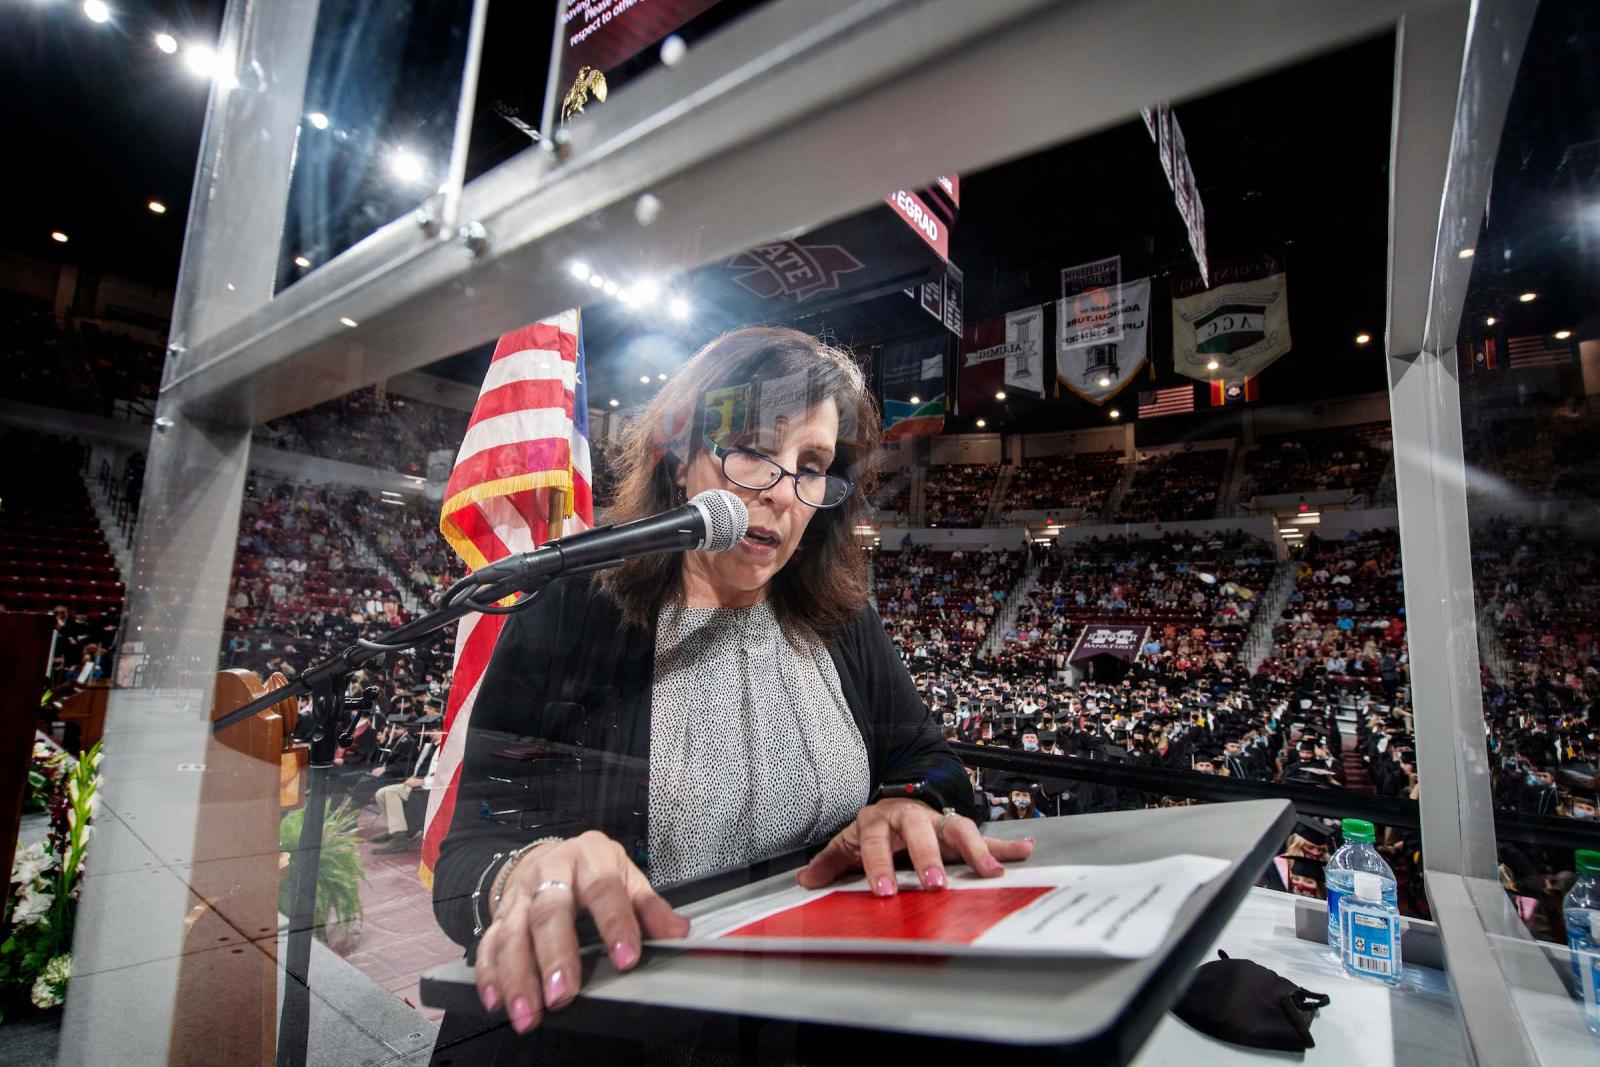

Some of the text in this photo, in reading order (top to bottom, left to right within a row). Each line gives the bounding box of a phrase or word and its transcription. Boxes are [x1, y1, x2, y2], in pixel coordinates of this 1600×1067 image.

[570, 17, 601, 46] respect
[602, 11, 612, 24] to
[756, 243, 813, 285] ATE
